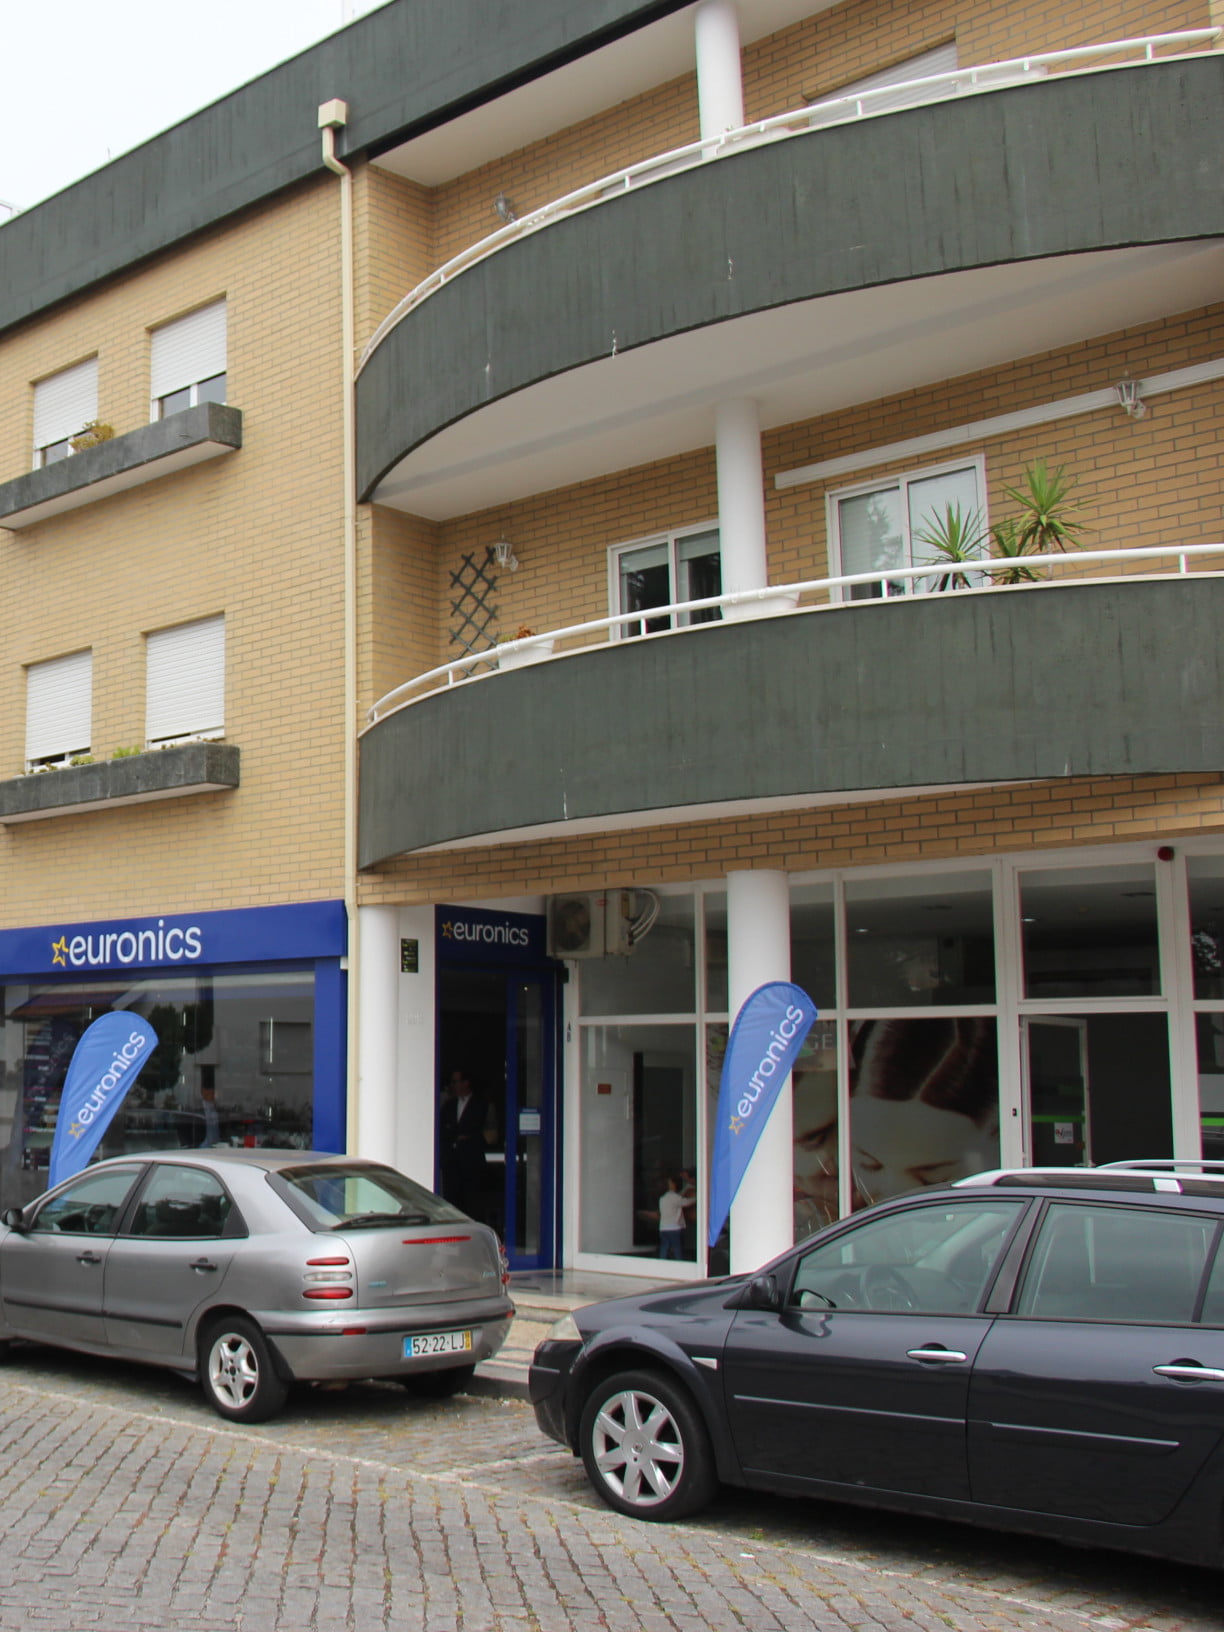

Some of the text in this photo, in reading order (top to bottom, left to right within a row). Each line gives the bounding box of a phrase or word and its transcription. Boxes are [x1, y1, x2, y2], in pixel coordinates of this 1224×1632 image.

[69, 919, 202, 965] euronics
[453, 921, 529, 946] euronics
[78, 1031, 146, 1125] euronics
[737, 1004, 804, 1118] euronics
